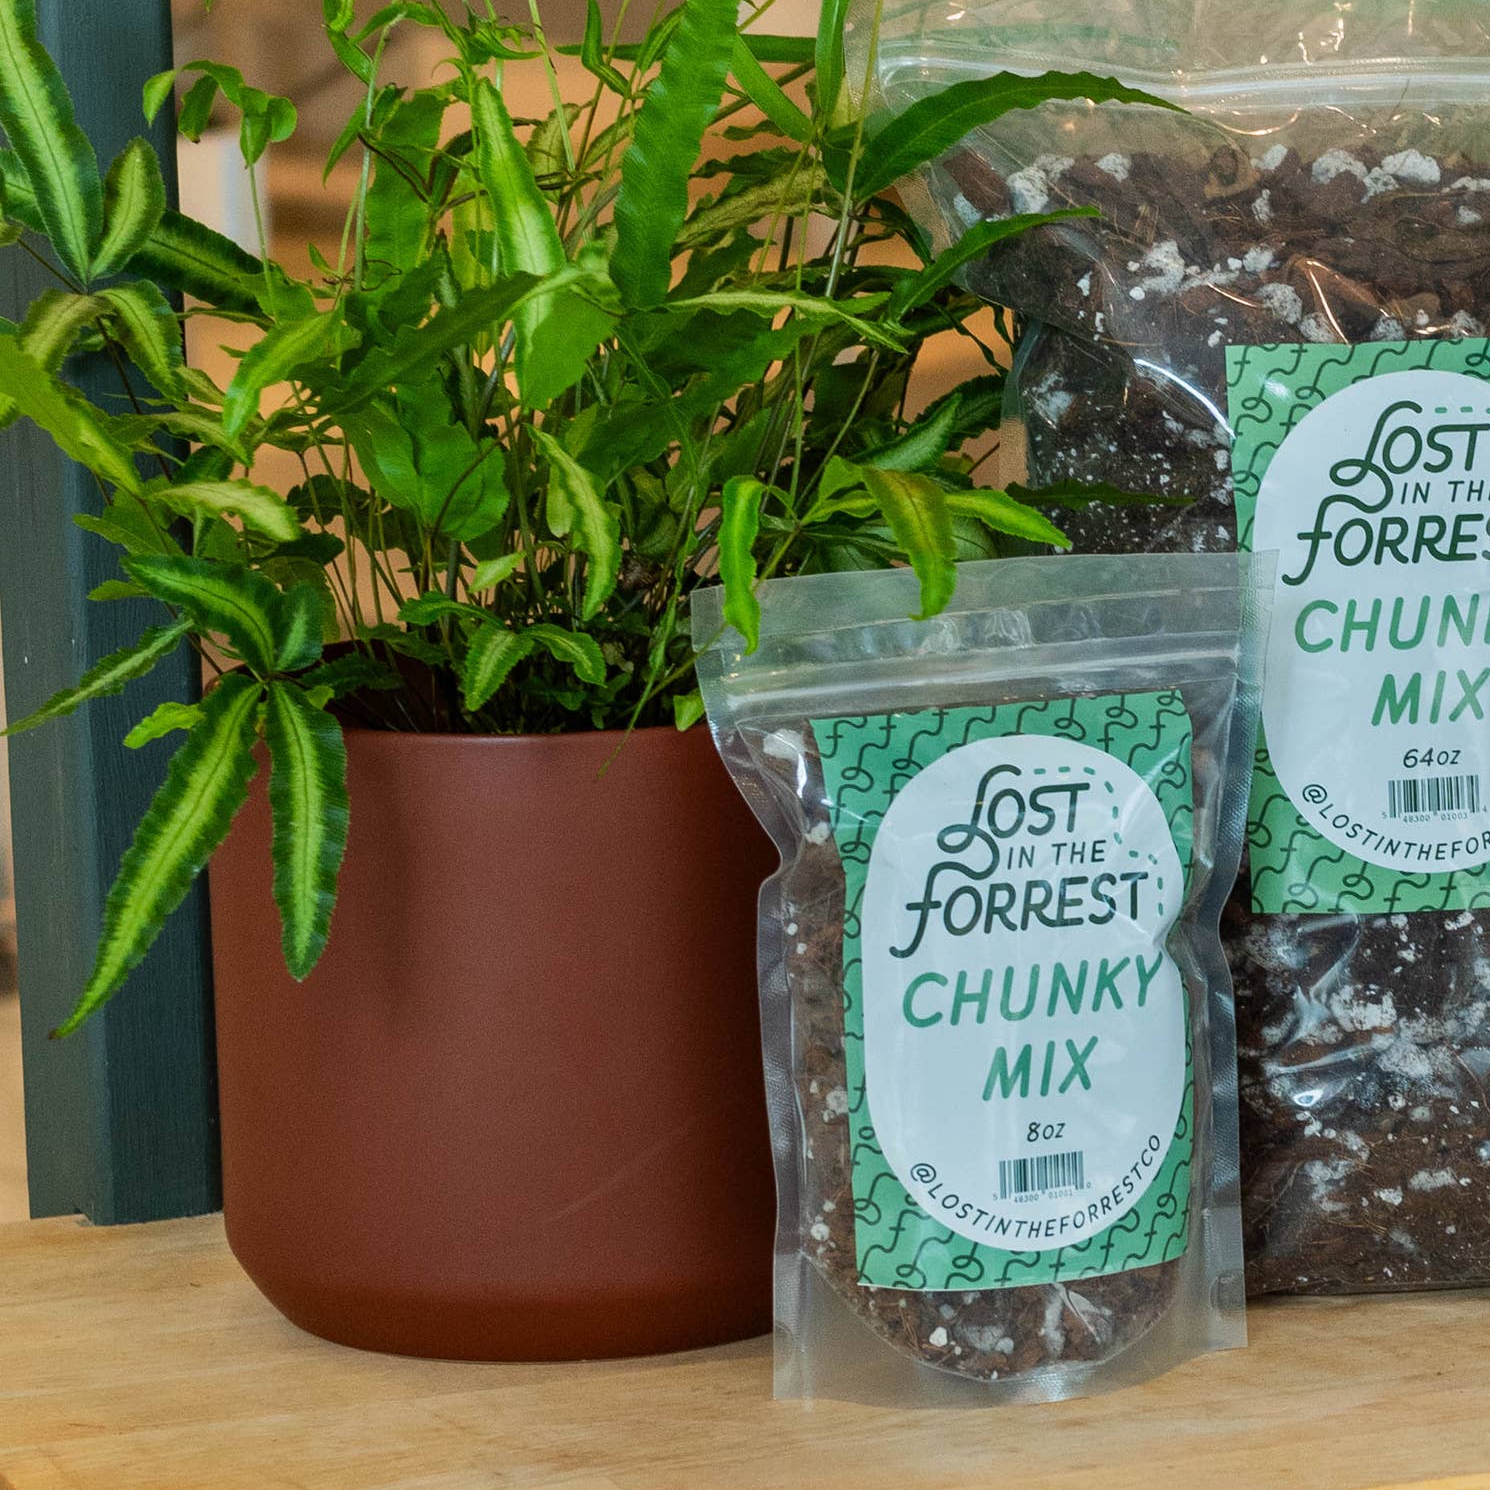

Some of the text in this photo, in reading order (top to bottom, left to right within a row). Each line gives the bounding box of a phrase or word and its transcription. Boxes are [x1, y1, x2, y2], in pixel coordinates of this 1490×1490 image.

[1329, 400, 1490, 506] LOST
[1400, 482, 1426, 505] IN
[1371, 667, 1490, 727] MIX
[937, 763, 1091, 879] LOST
[1007, 839, 1107, 870] IN THE
[902, 950, 1163, 1028] CHUNKY
[982, 1036, 1098, 1102] MIX
[910, 1134, 1162, 1238] @LOSTINTHEFORRESTCO
